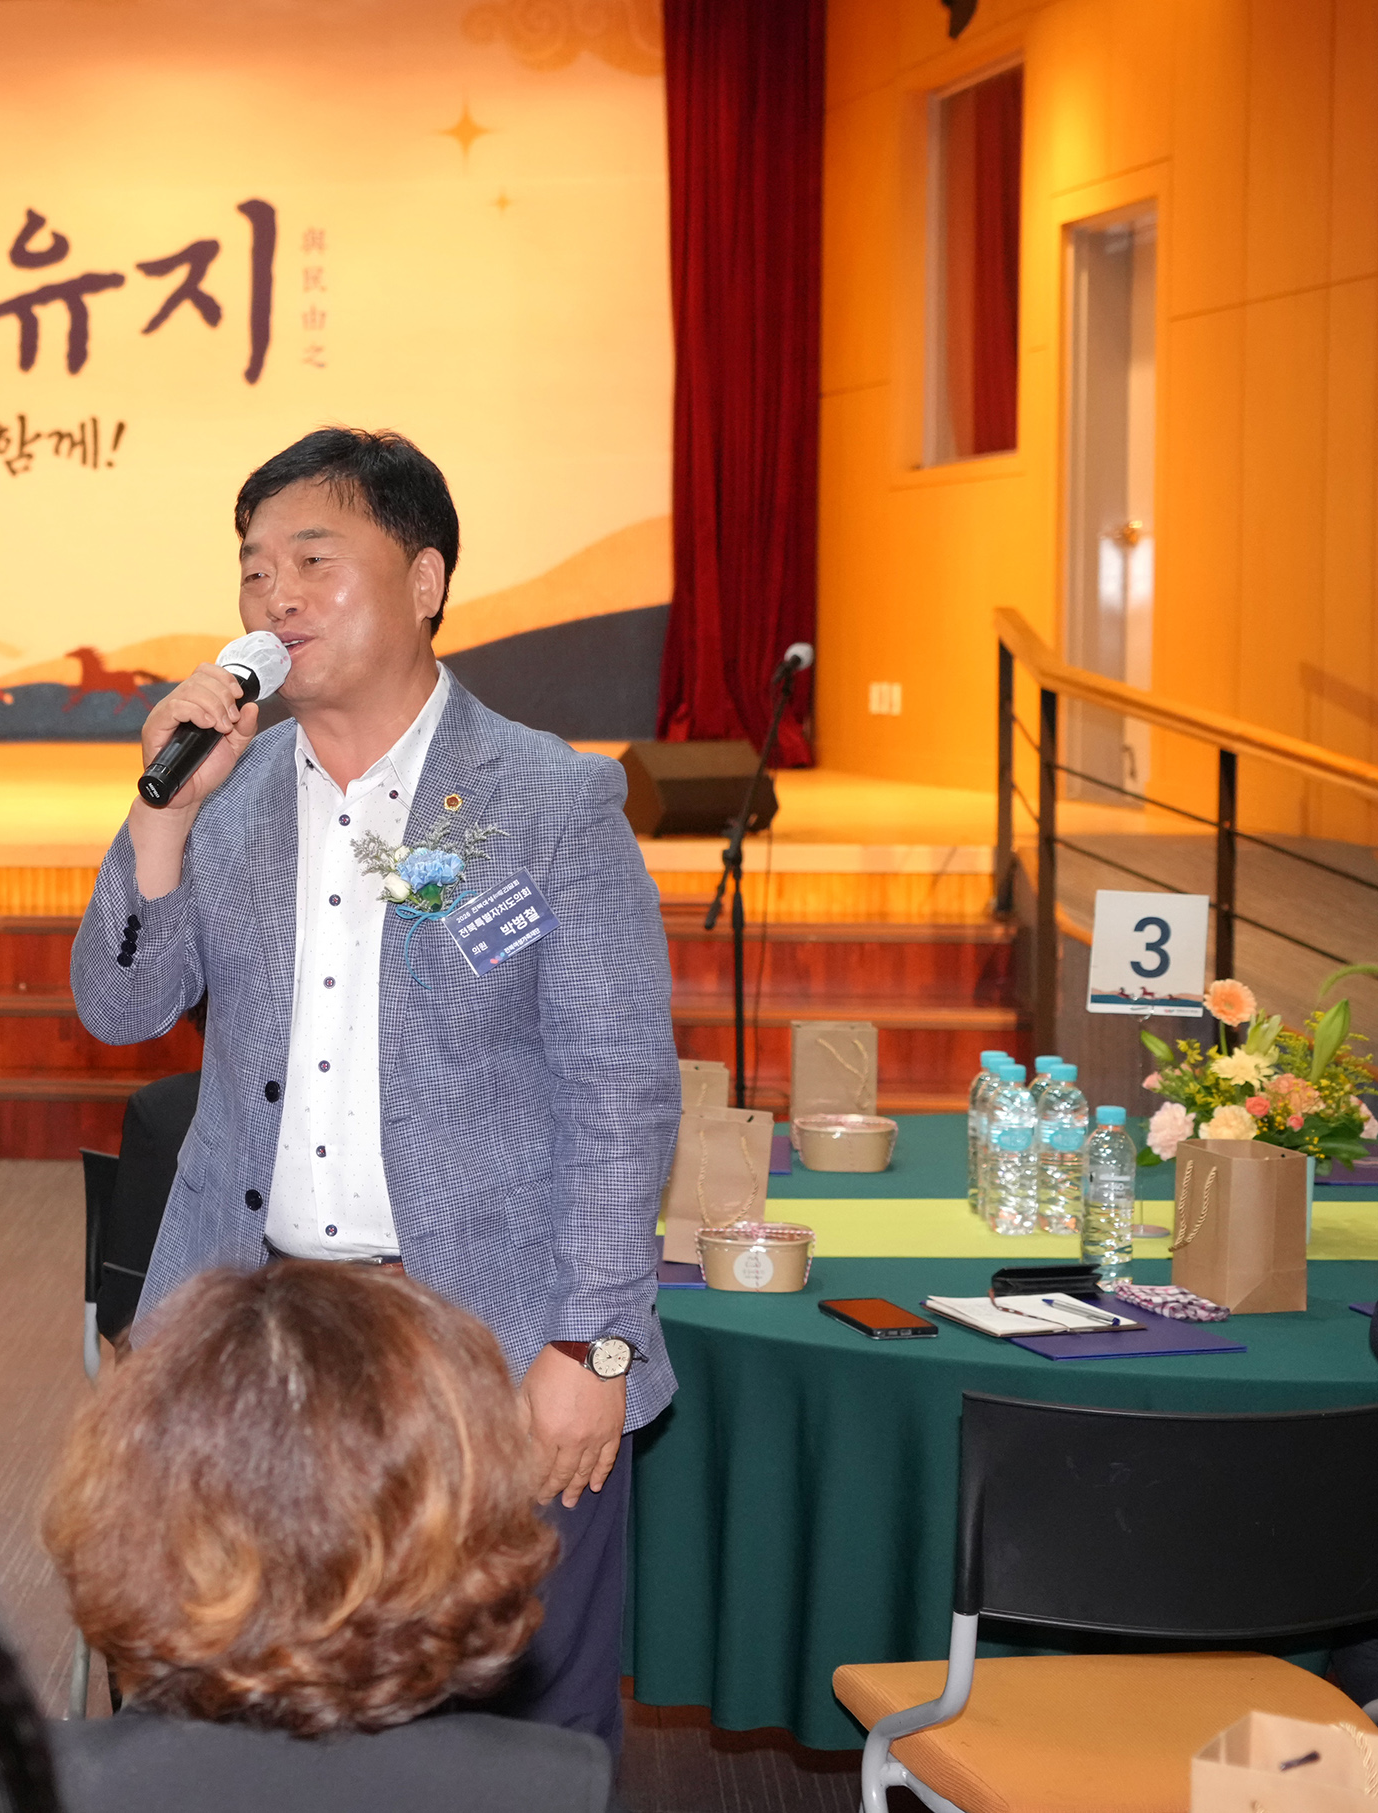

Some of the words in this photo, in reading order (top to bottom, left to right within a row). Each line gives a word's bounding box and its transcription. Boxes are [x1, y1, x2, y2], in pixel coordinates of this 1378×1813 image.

[458, 886, 532, 938] 전북특별자치도의회
[471, 941, 489, 956] 의원
[499, 906, 540, 936] 박병철
[1130, 916, 1172, 978] 3
